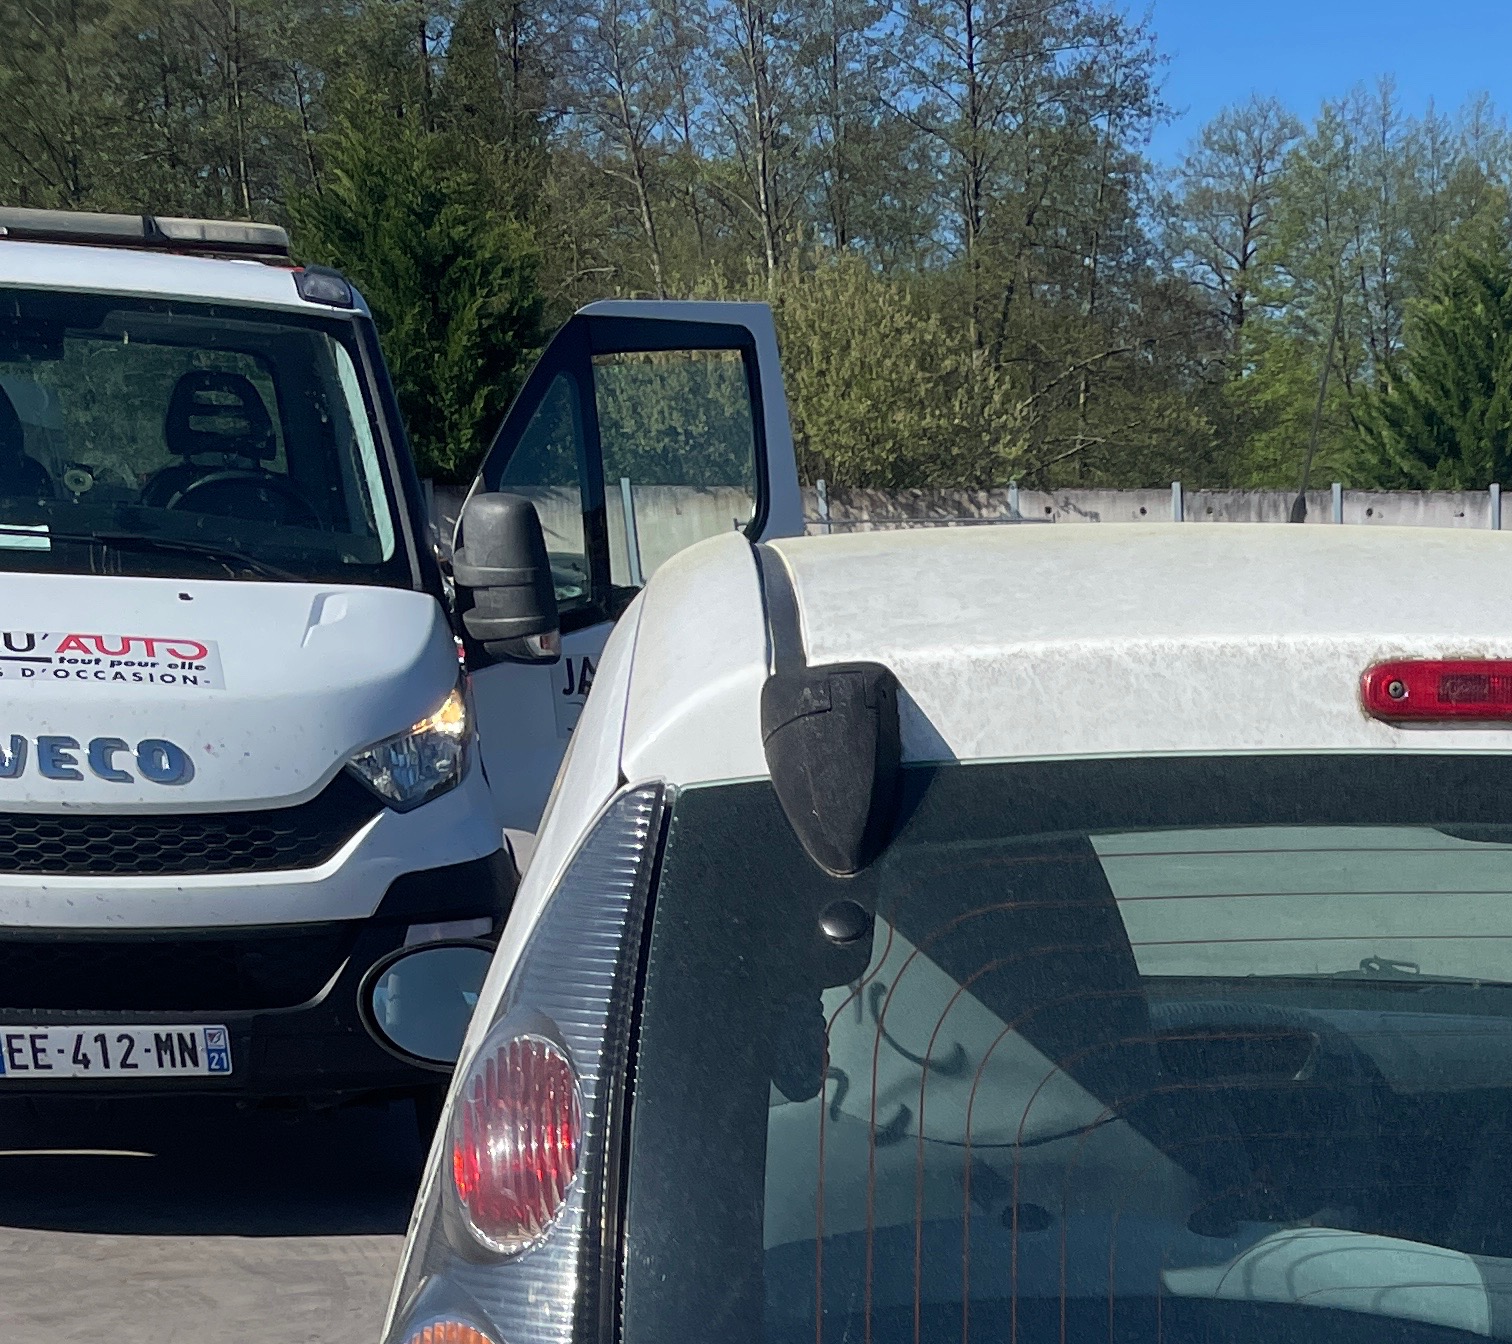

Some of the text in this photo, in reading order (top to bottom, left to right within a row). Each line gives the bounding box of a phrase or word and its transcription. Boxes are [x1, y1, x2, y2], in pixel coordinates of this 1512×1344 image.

[58, 656, 207, 672] tout pour elle
[5, 1033, 200, 1070] EE-412-MN
[209, 1053, 229, 1070] 21
